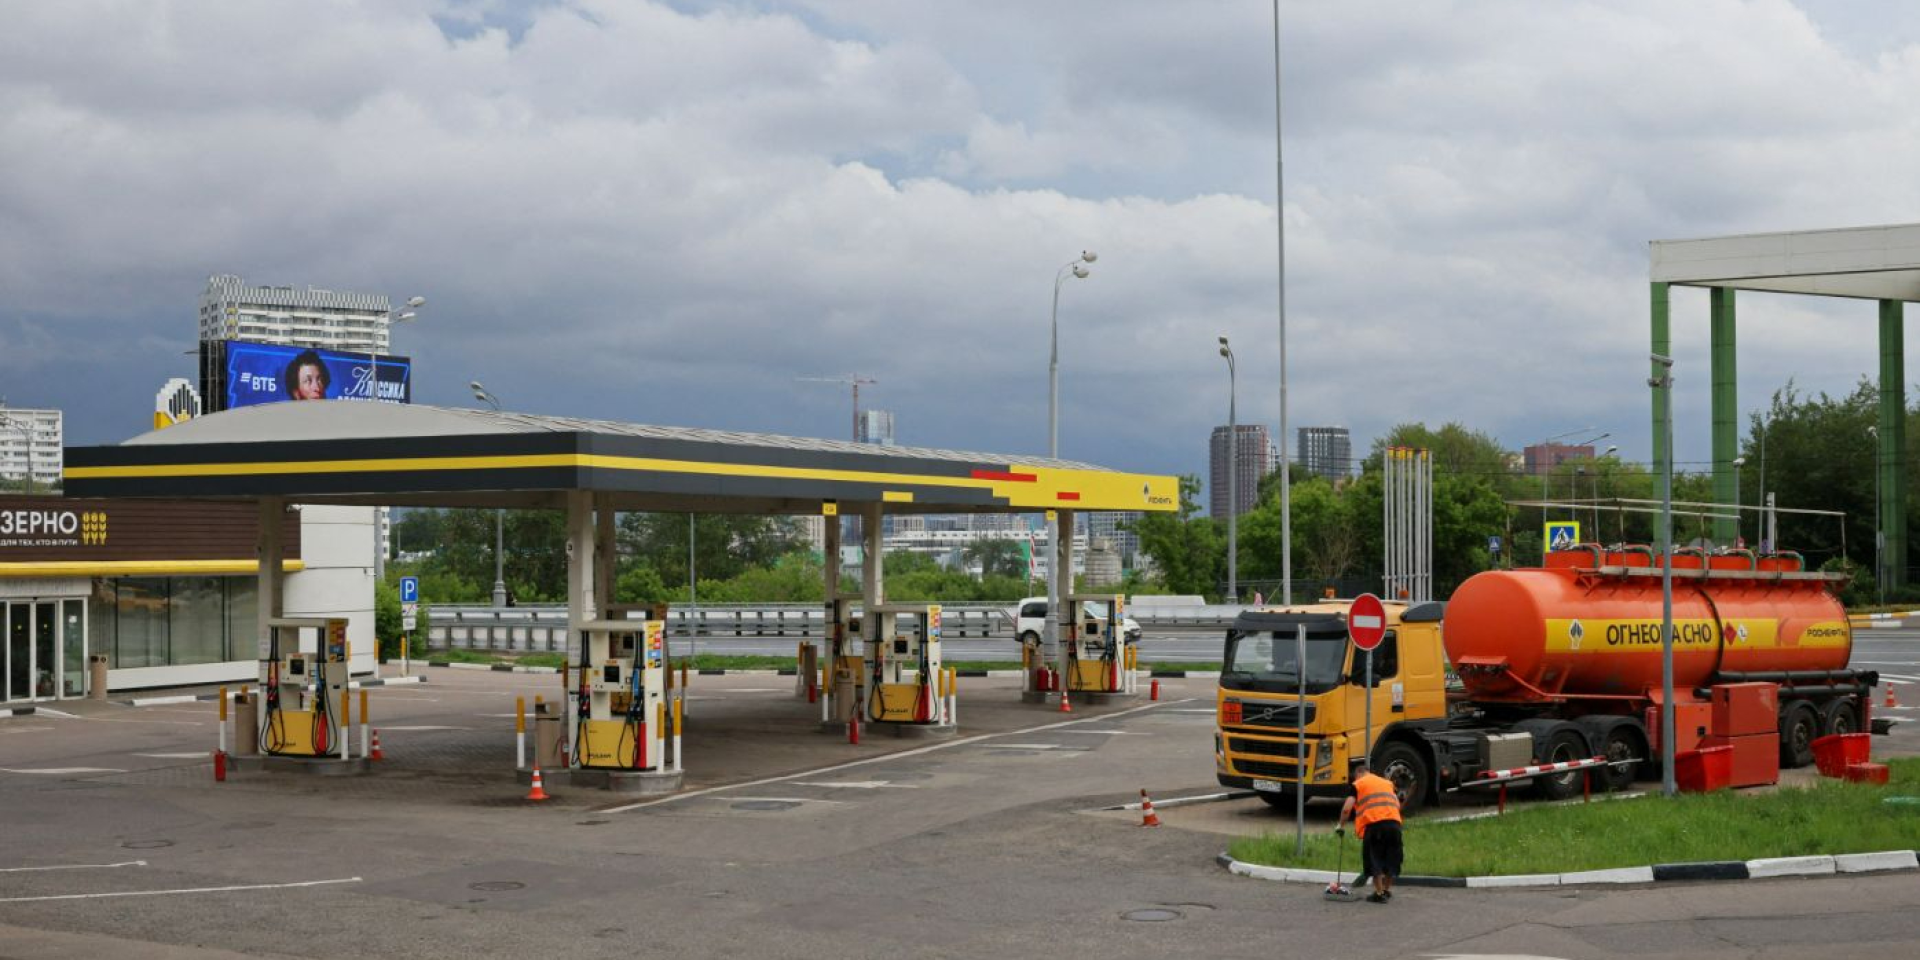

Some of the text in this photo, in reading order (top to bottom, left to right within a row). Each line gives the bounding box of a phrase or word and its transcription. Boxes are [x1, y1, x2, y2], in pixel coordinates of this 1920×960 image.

[252, 376, 276, 392] ВТБ
[344, 366, 405, 399] КЛССИКА
[0, 511, 78, 534] ЗЕРНО
[405, 580, 415, 600] P
